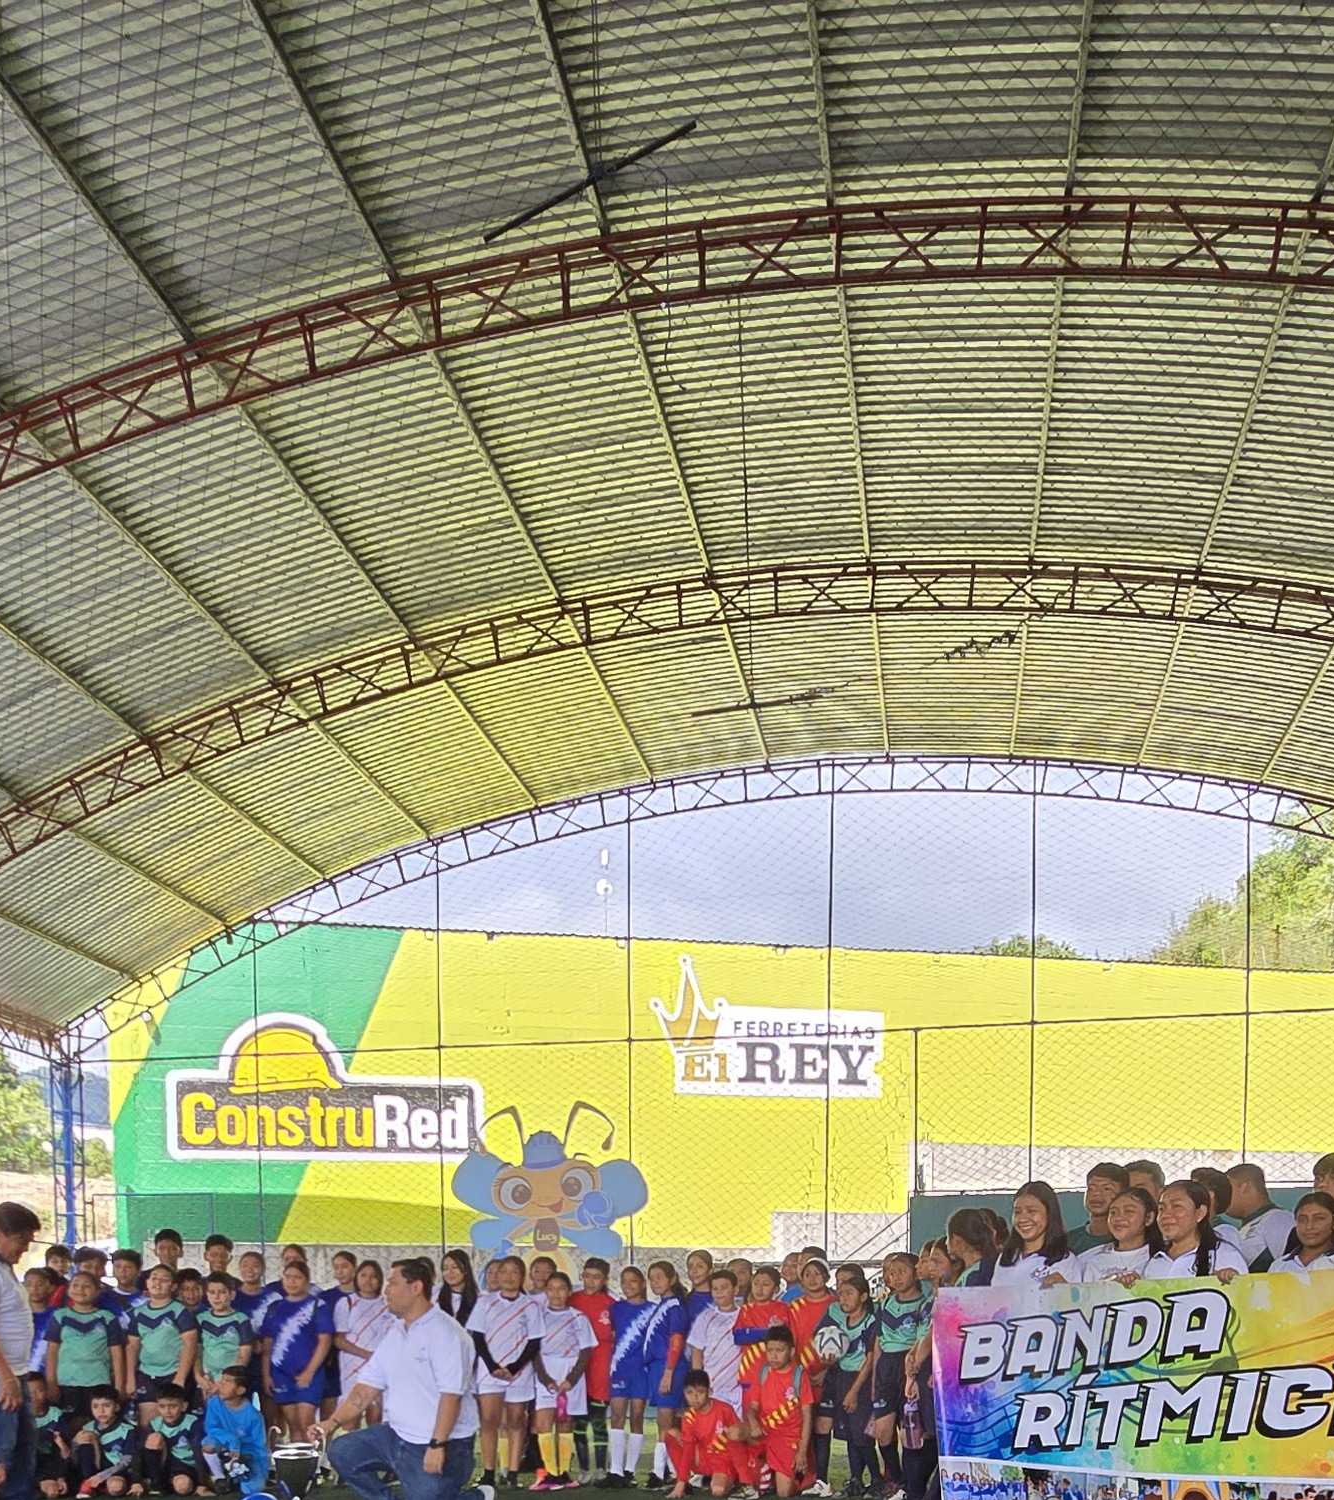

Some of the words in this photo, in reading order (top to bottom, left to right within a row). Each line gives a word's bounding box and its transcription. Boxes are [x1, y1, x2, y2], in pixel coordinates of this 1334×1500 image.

[733, 1020, 876, 1040] FERRETERIAS
[681, 1053, 731, 1084] El
[737, 1042, 875, 1087] REY
[180, 1092, 469, 1149] ConstruRed
[536, 1229, 558, 1244] Lucy
[960, 1289, 1229, 1383] BANDA
